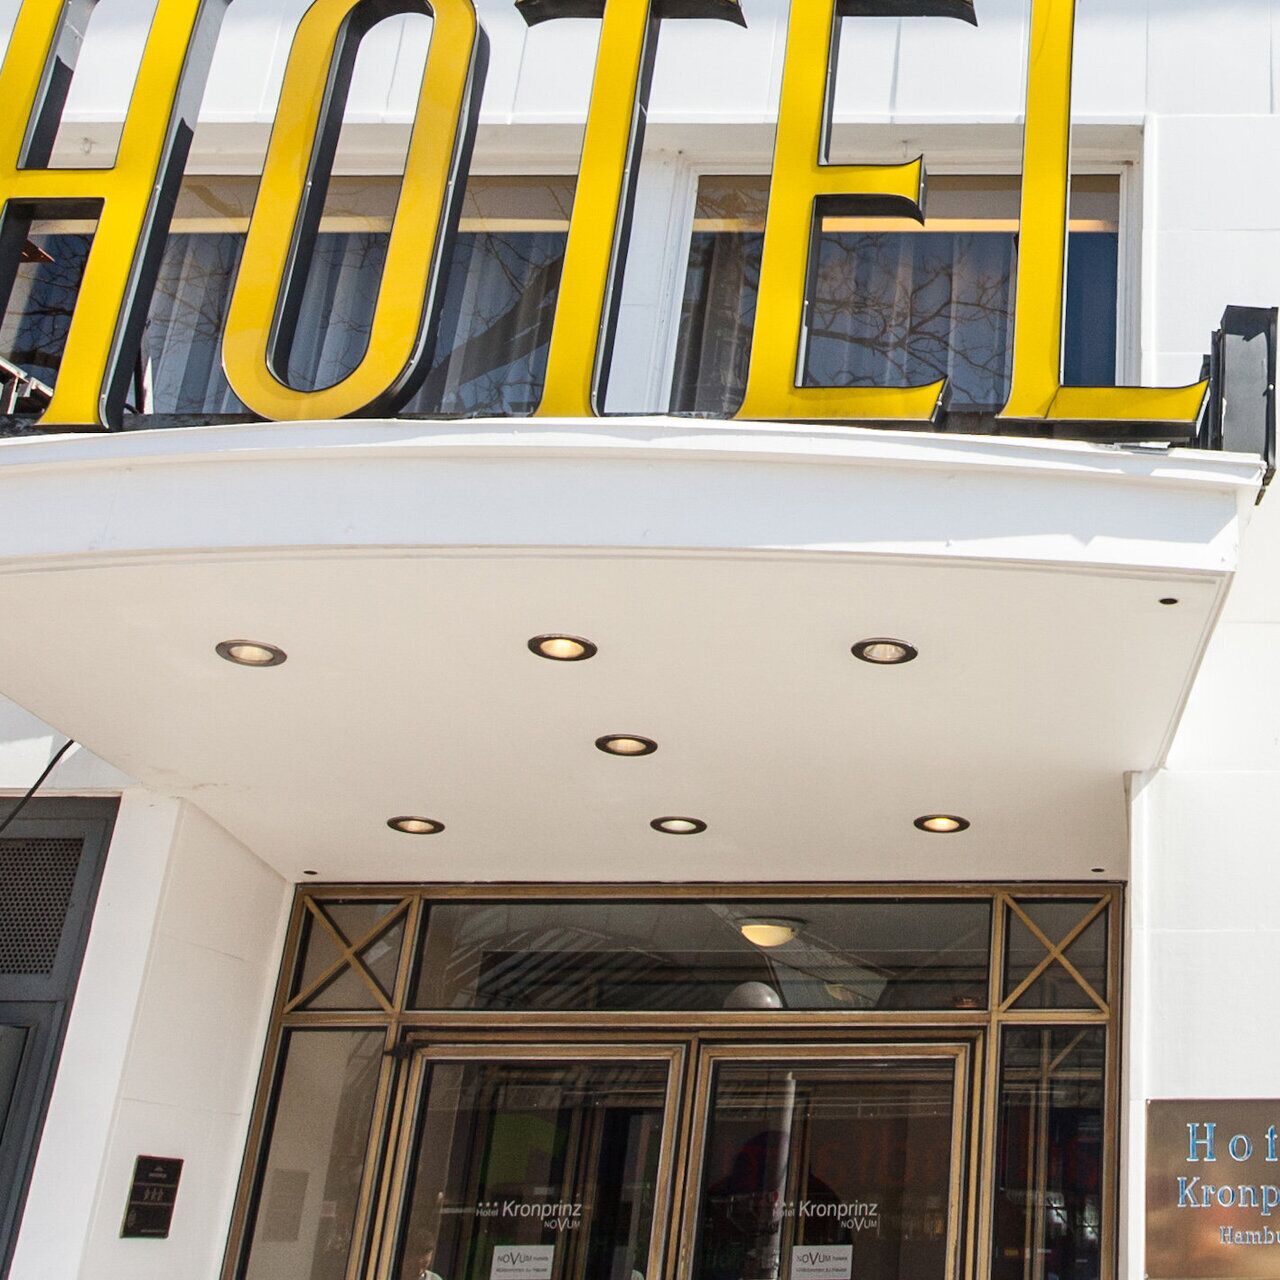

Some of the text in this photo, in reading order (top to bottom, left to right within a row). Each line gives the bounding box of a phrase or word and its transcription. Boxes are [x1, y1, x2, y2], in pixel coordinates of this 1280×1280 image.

[502, 1199, 583, 1221] Kronprinz
[798, 1199, 878, 1221] Kronprinz
[544, 1217, 581, 1232] NOVUM
[840, 1217, 878, 1232] NOVUM
